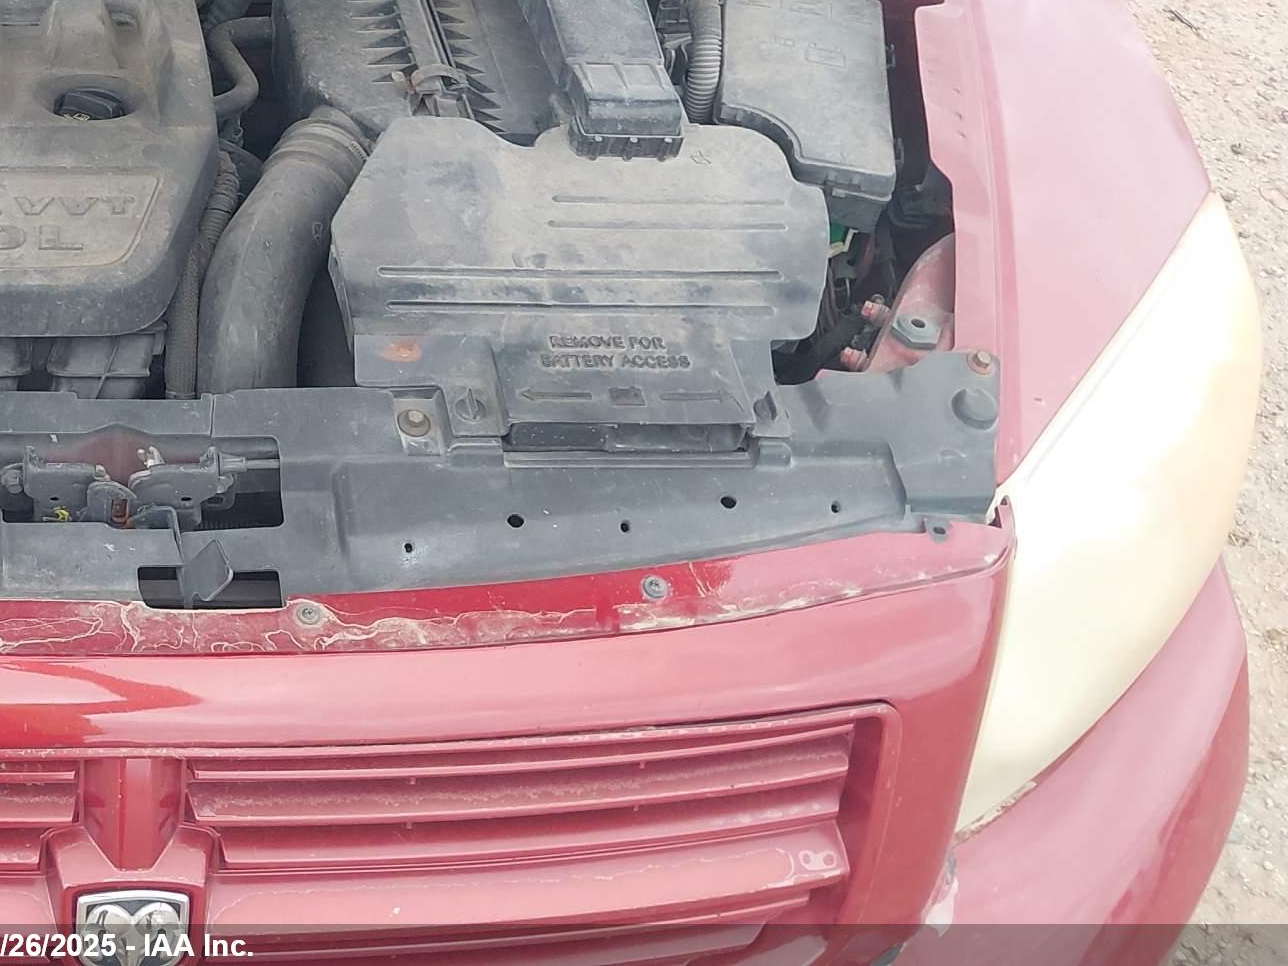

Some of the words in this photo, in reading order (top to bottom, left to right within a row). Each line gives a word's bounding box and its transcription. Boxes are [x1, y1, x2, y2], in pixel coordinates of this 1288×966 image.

[14, 194, 138, 217] VVT
[548, 334, 626, 350] REMOVE
[629, 335, 666, 351] FOR
[539, 353, 616, 369] BATTERY
[621, 354, 692, 369] ACCESS
